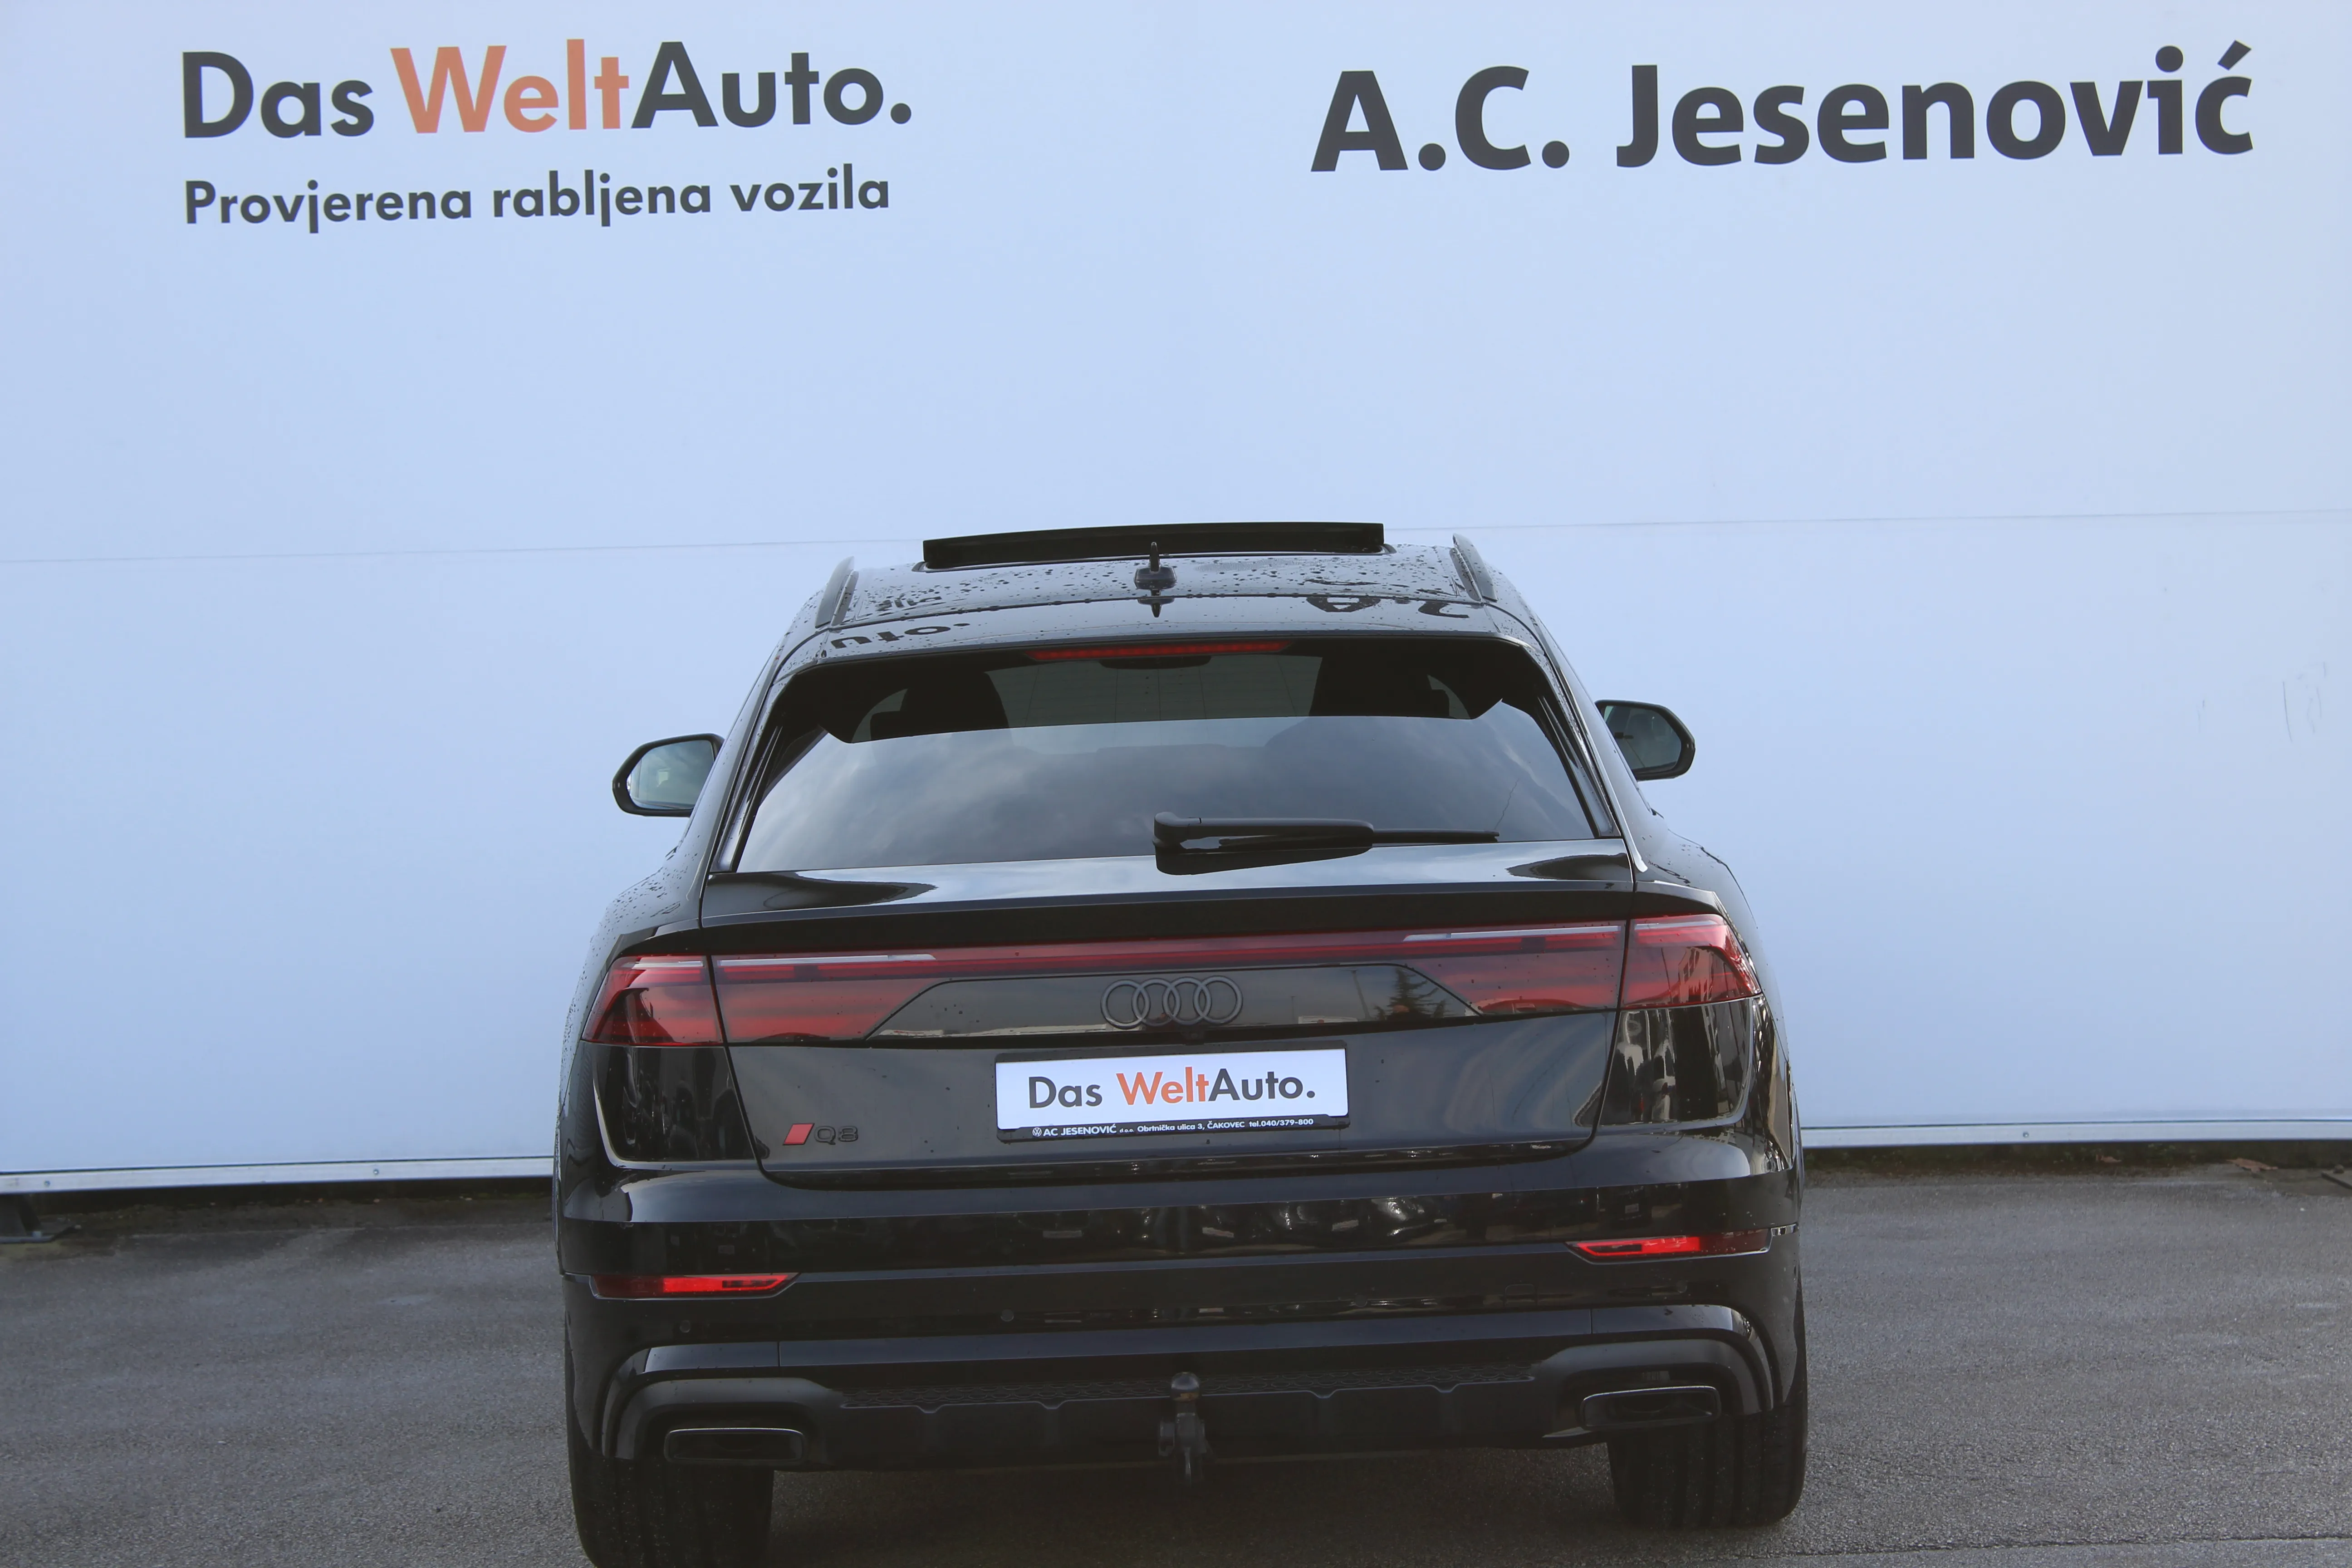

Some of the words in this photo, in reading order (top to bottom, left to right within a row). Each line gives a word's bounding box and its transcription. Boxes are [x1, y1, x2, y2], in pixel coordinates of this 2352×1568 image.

[182, 51, 373, 138] Das
[390, 39, 911, 133] WeltAuto.
[1311, 66, 1570, 172] A.C.
[1617, 40, 2253, 167] Jesenović
[186, 180, 471, 234] Provjerena
[493, 169, 710, 227] rabljena
[730, 163, 888, 211] vozila
[1029, 1077, 1102, 1108] Das
[1116, 1067, 1315, 1105] WeltAuto.
[813, 1126, 858, 1145] Q8
[1043, 1128, 1058, 1137] AC
[1061, 1124, 1117, 1136] JESENOVIĆ
[1137, 1123, 1175, 1132] Obrtnička
[1177, 1121, 1196, 1131] ulica
[1207, 1120, 1245, 1129] ČAKOVEC
[1249, 1118, 1314, 1127] tel.040/379-800
